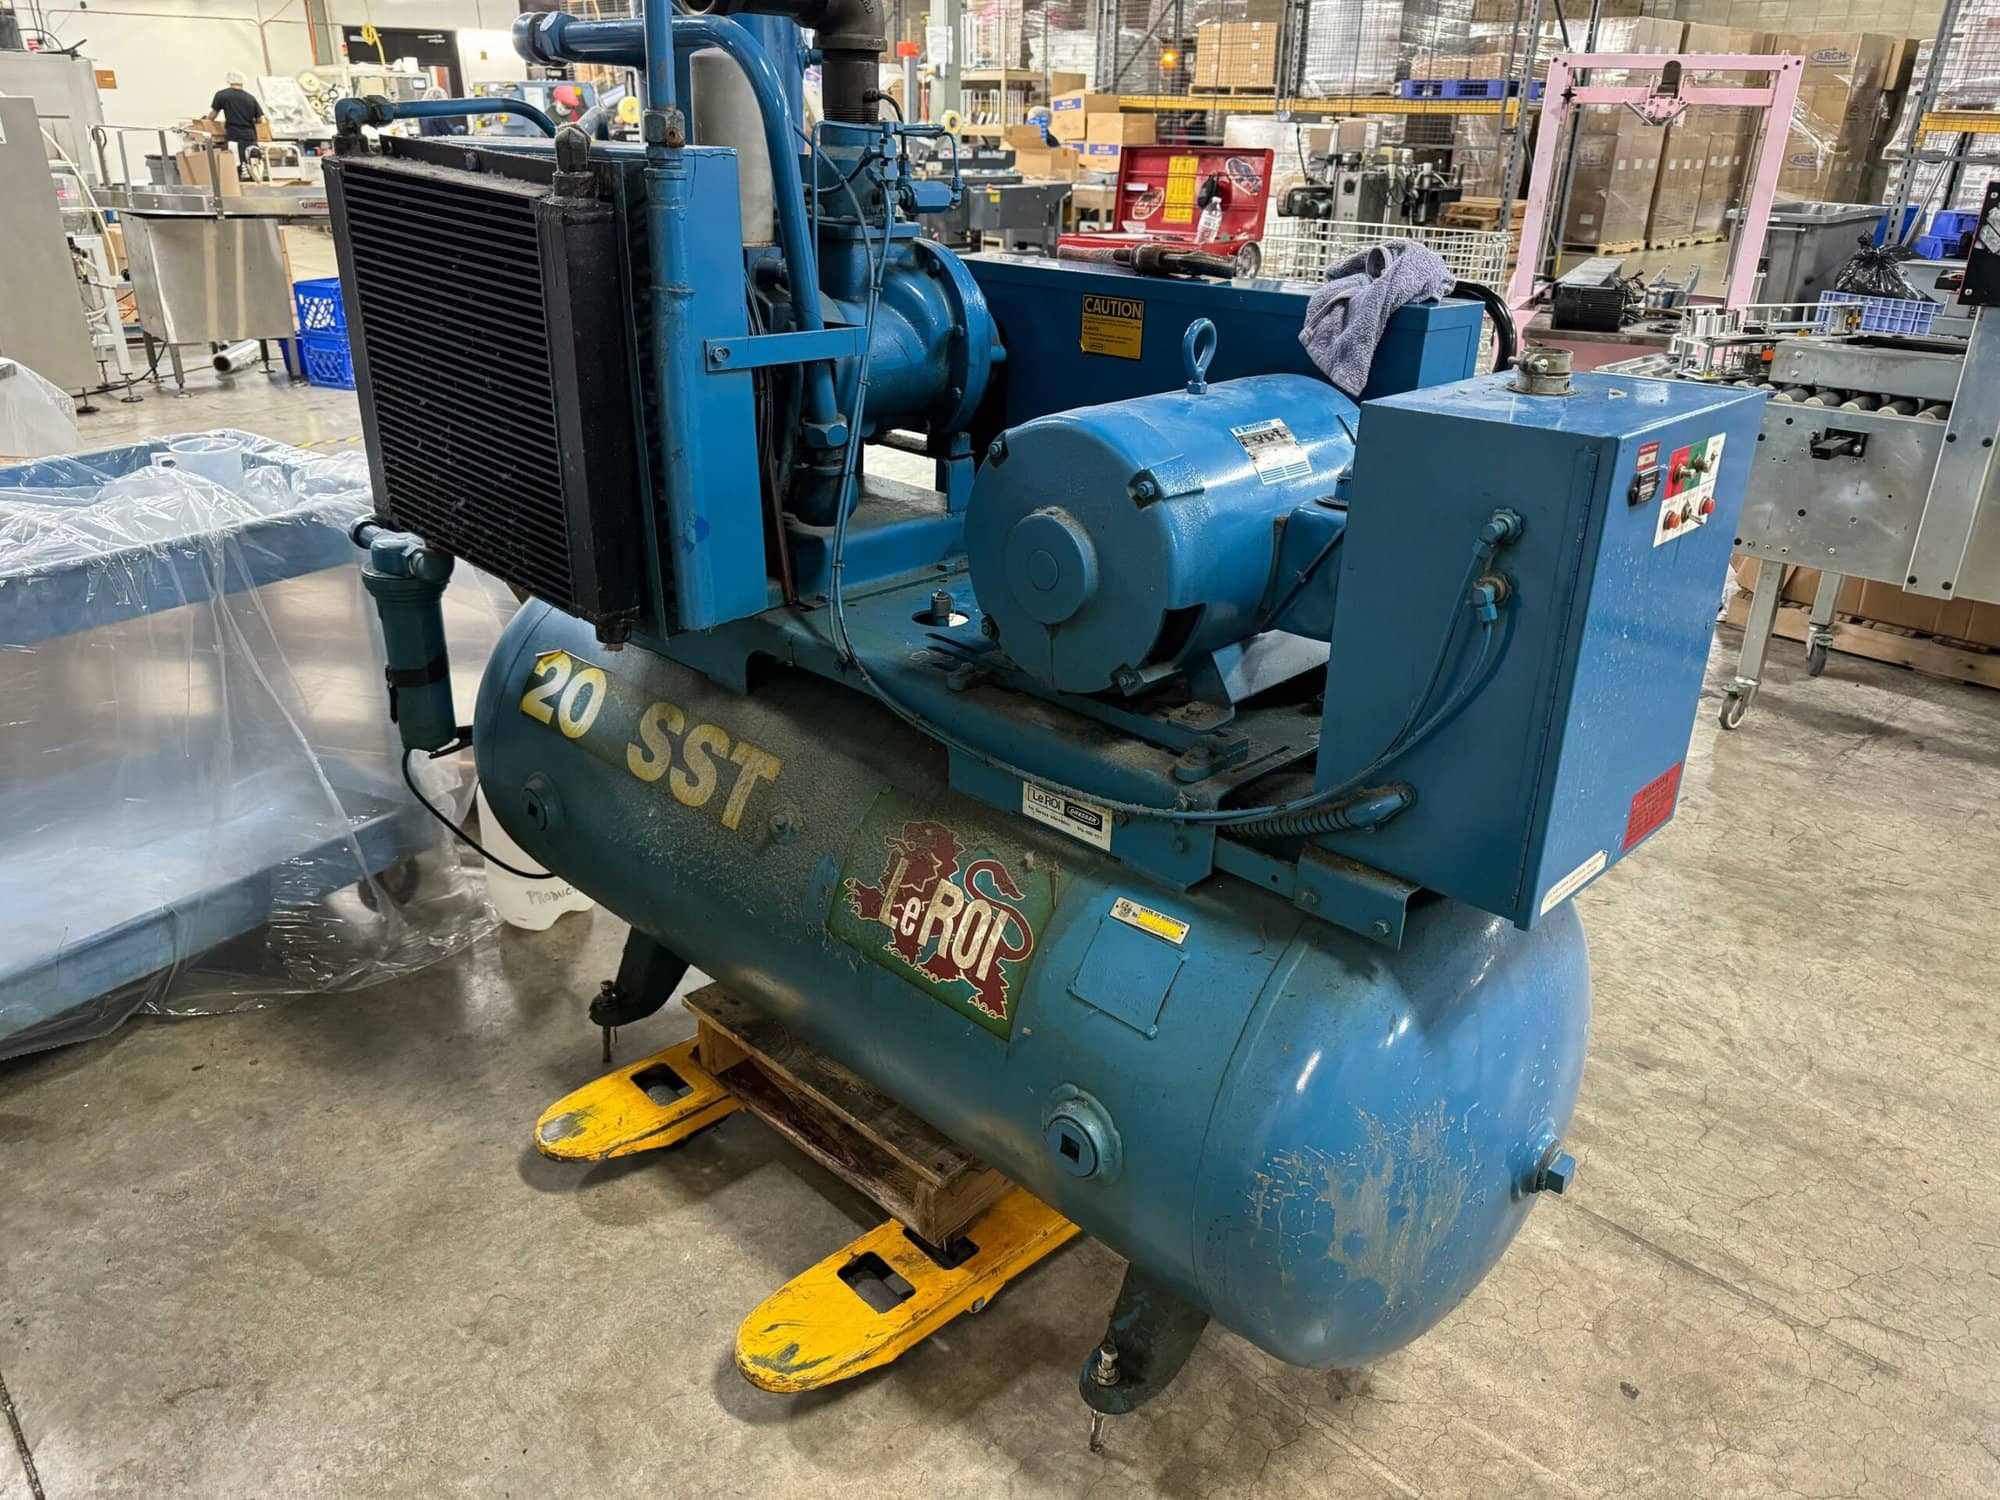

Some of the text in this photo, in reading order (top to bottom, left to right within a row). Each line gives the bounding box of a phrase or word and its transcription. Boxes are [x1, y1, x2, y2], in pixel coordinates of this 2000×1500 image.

[1816, 51, 1848, 60] ARCH
[1793, 155, 1820, 165] ARC
[1084, 297, 1142, 319] CAUTION
[519, 652, 784, 832] 20 SST
[1069, 808, 1098, 824] DRESSER
[1140, 906, 1154, 916] STATE
[1161, 914, 1186, 928] WISCONSIN
